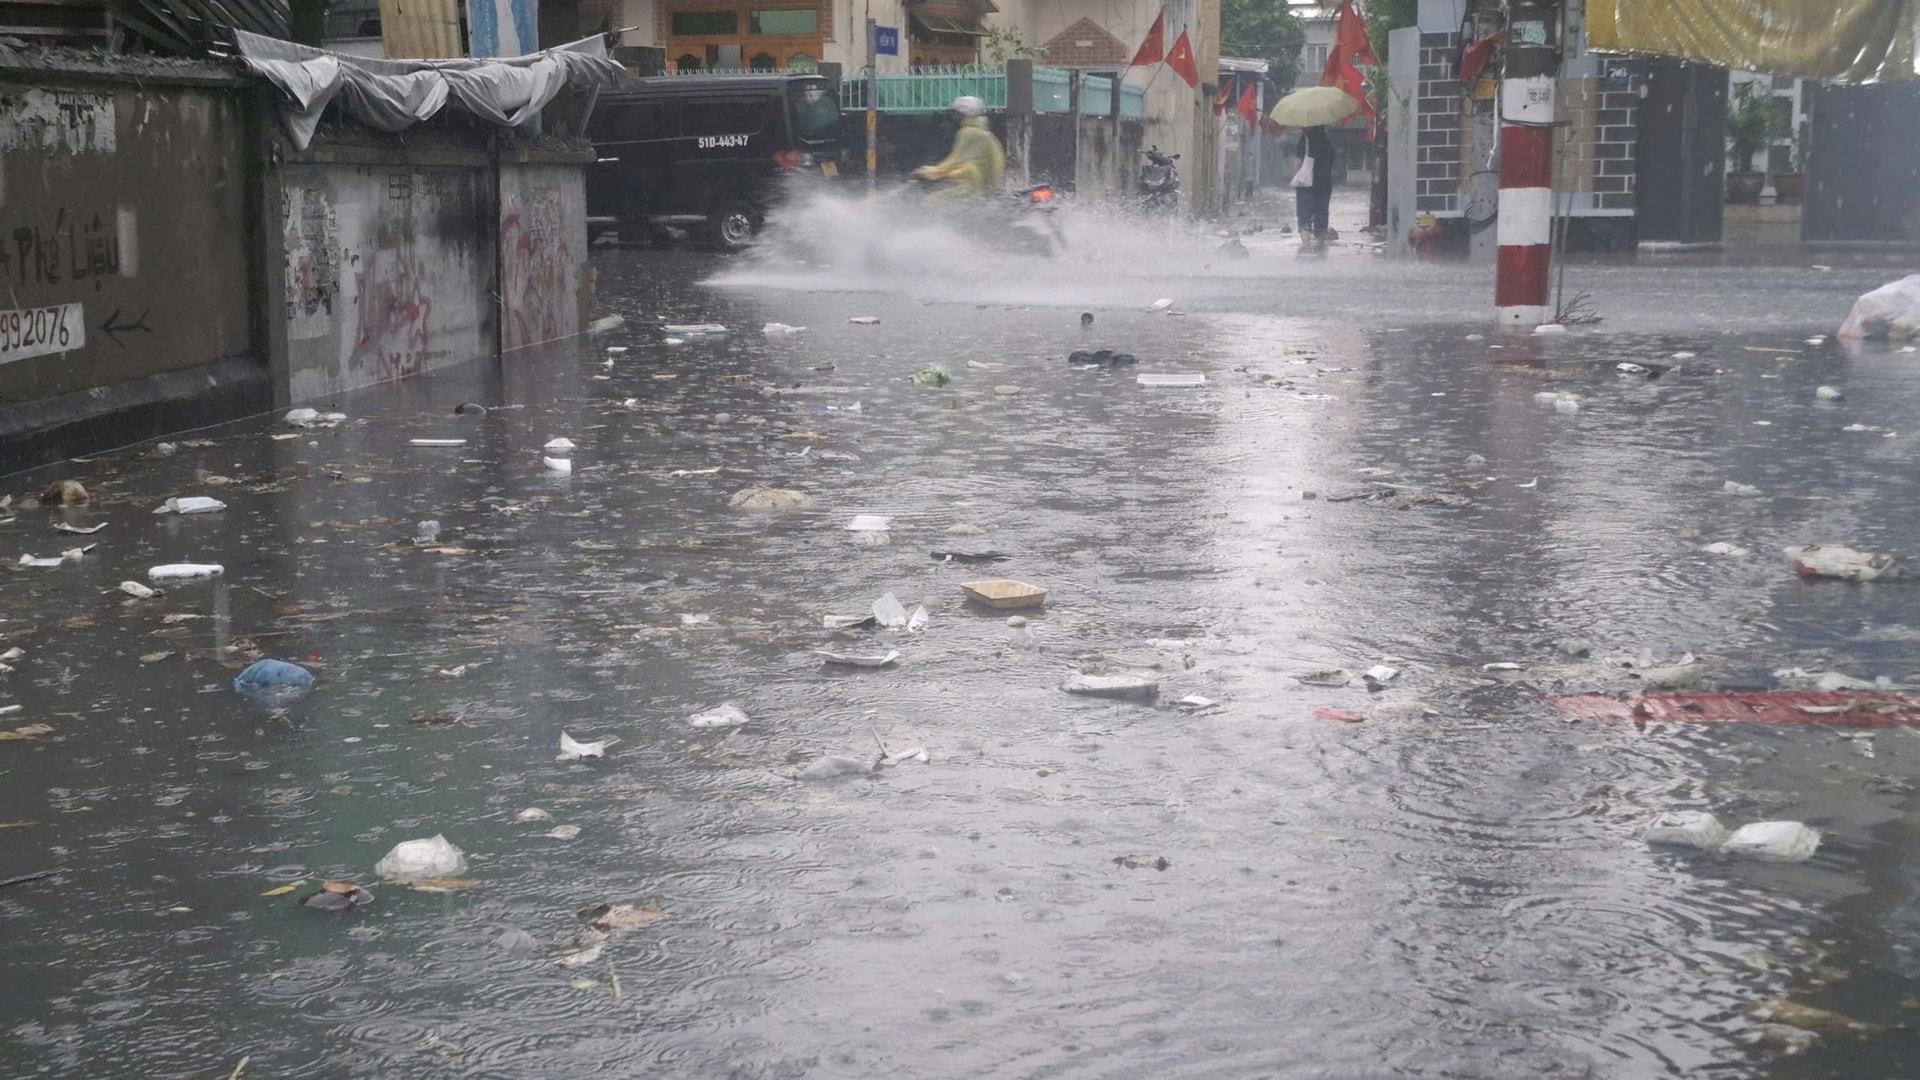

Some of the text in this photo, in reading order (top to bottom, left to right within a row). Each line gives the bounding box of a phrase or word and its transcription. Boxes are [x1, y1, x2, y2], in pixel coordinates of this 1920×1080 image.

[12, 206, 64, 286] Phế
[70, 211, 120, 292] Liệu
[0, 306, 70, 352] 992076
